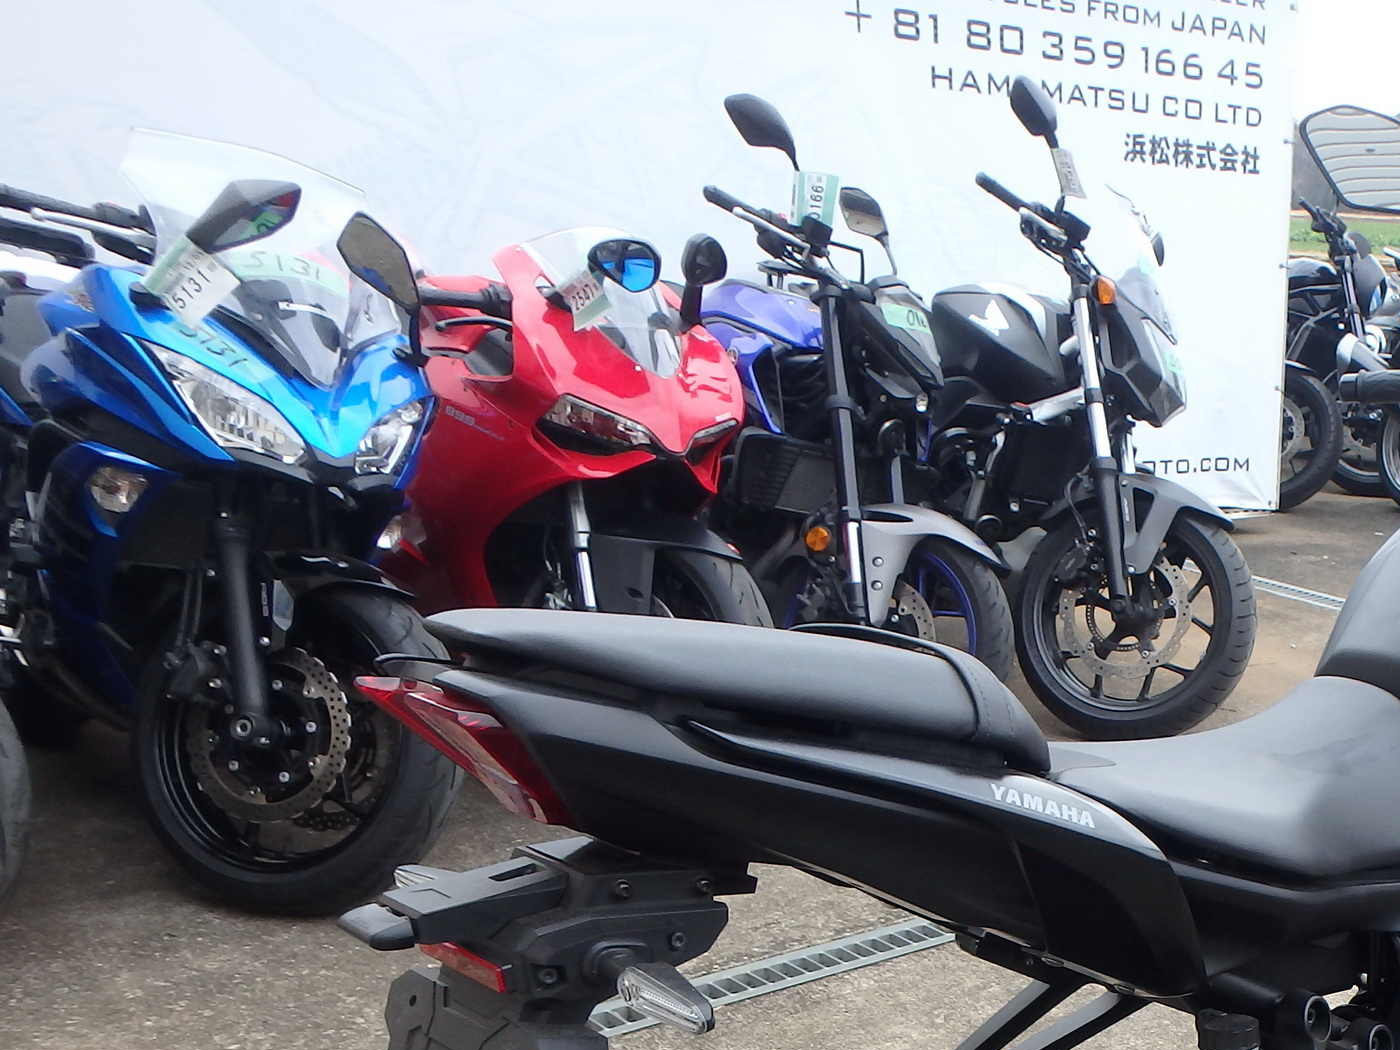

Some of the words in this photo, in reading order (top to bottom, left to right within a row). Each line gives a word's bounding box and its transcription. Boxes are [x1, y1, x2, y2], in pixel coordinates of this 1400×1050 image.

[1087, 0, 1161, 28] FROM
[1171, 11, 1266, 46] JAPAN
[893, 7, 939, 44] 81
[966, 19, 1024, 55] 80
[1041, 30, 1126, 69] 359
[1141, 46, 1203, 81] 166
[1217, 58, 1263, 90] 45
[930, 65, 1150, 114] HAMMATSU
[1162, 95, 1202, 121] CO
[1214, 102, 1262, 128] LTD
[1123, 132, 1260, 175] 浜松株式会社
[243, 251, 321, 281] 5131
[172, 268, 211, 310] 5131
[572, 283, 595, 311] 2547
[990, 783, 1096, 829] YAMAHA
